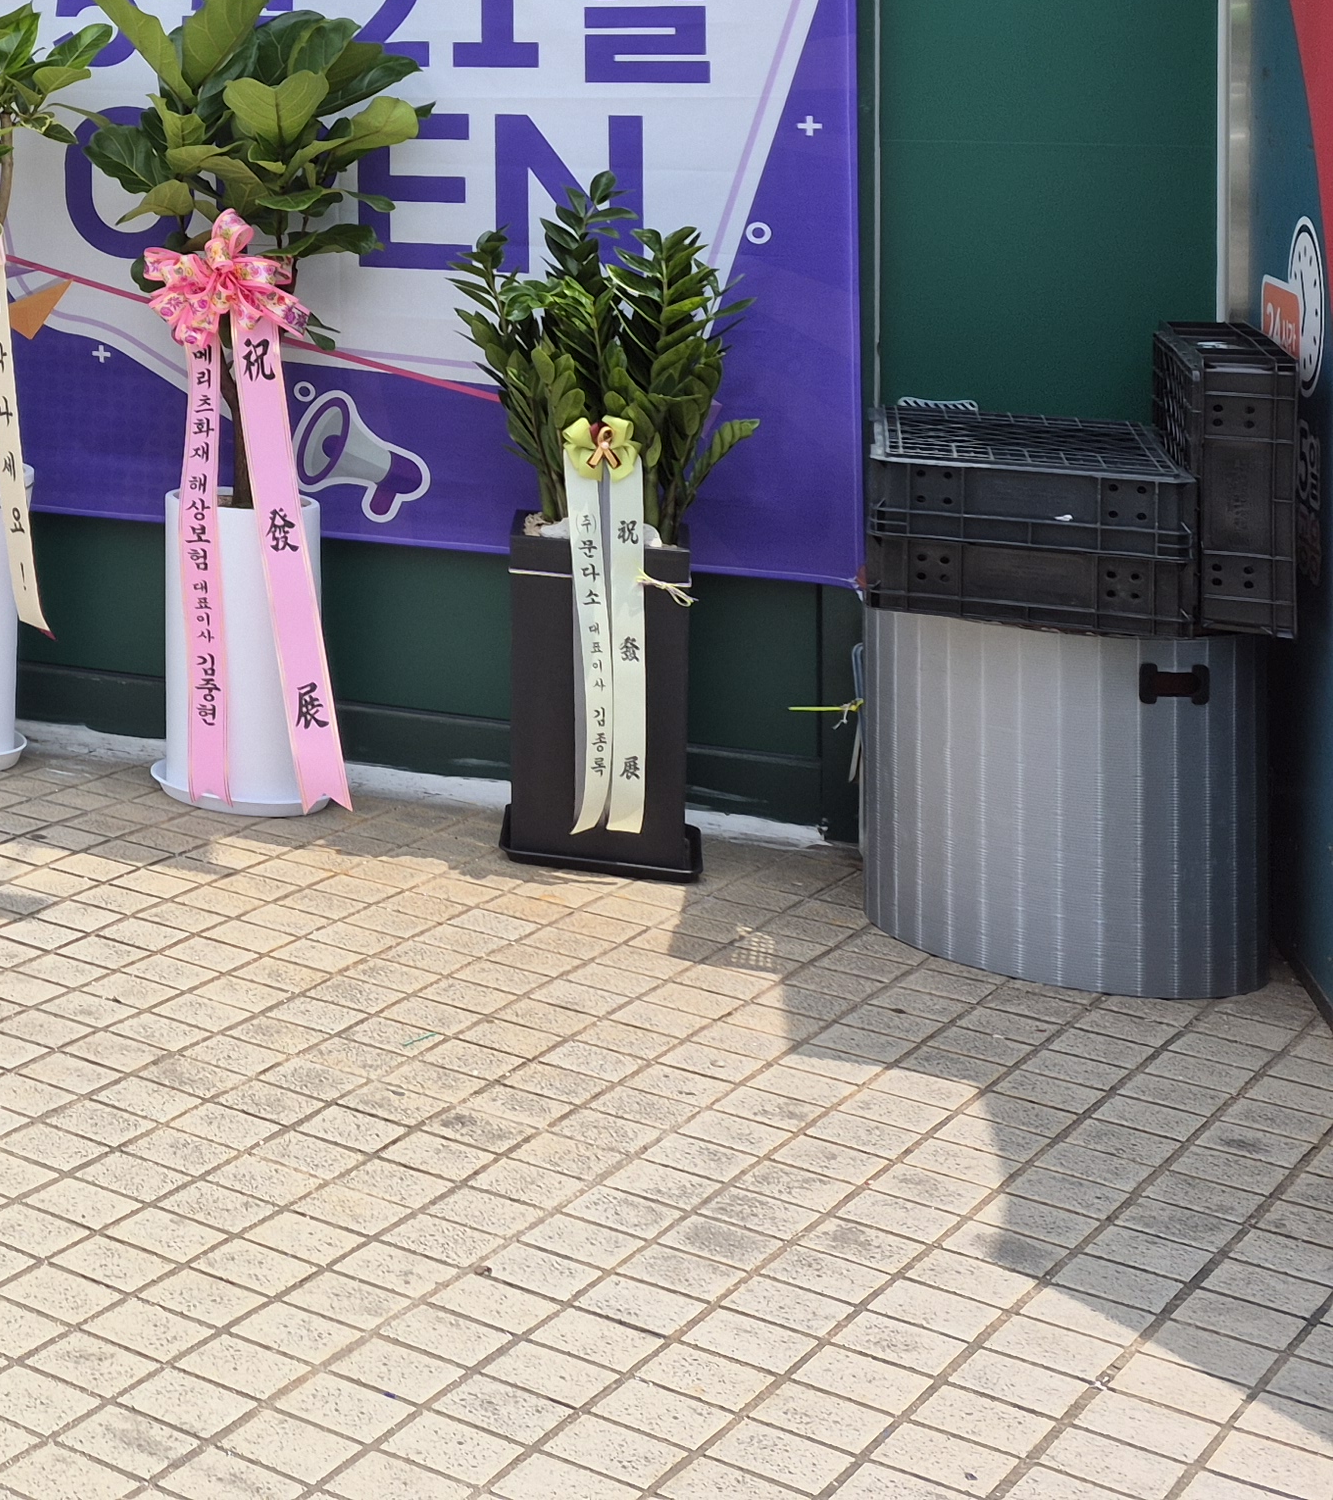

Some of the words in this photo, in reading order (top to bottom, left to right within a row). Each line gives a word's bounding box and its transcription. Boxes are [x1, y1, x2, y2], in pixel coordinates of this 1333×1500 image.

[185, 473, 212, 572] 해상보험
[193, 579, 216, 644] 대표이사
[193, 653, 222, 727] 김중현
[587, 622, 607, 692] 대표이사
